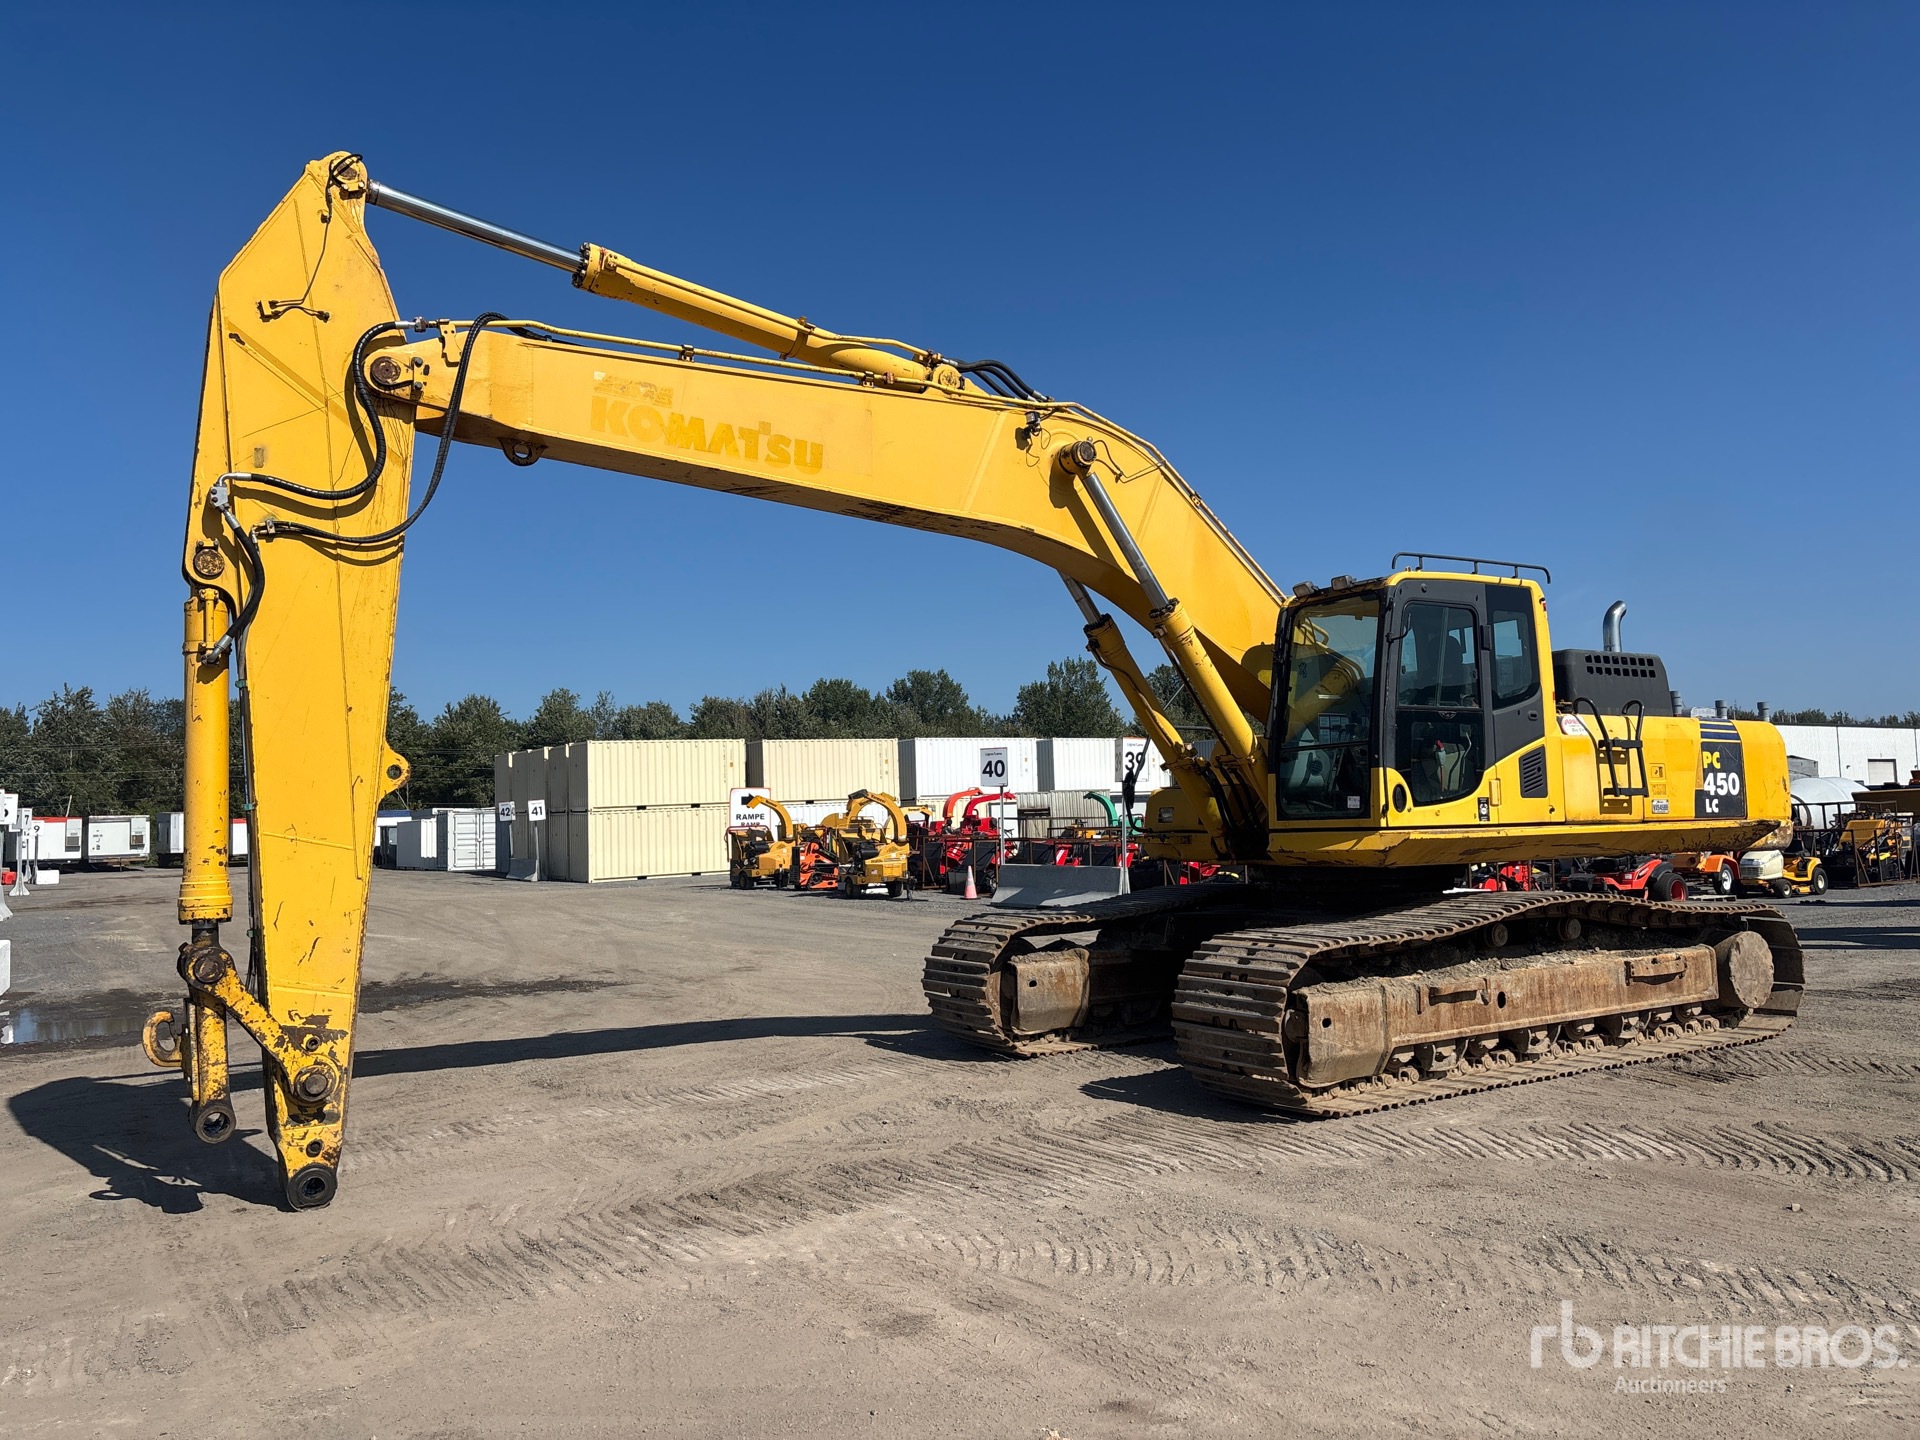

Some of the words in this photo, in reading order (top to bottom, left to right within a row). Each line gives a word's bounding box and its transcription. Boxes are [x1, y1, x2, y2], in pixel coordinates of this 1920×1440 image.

[591, 395, 824, 475] KOMATSU
[1702, 751, 1721, 769] PC
[982, 759, 1006, 778] 40
[1704, 772, 1740, 796] 450
[500, 807, 511, 817] 42
[531, 806, 543, 816] 41
[1705, 798, 1719, 813] LC
[24, 814, 30, 826] 7
[33, 824, 41, 834] 9
